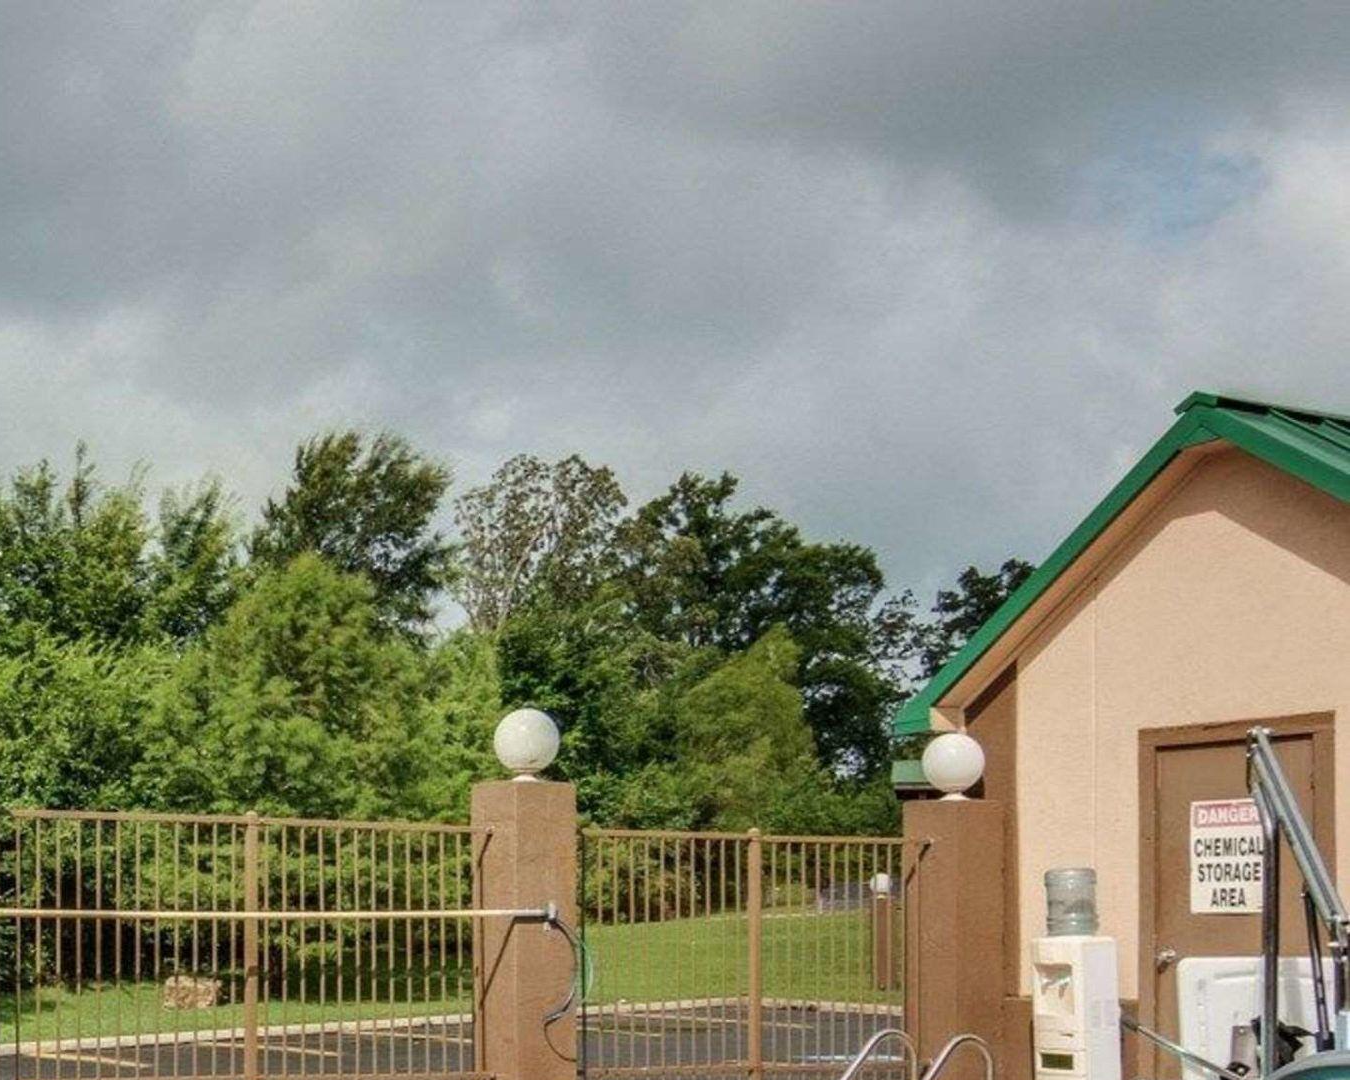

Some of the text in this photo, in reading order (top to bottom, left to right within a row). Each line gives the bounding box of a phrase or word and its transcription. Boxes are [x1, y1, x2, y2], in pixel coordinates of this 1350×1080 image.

[1194, 837, 1264, 857] CHEMICAL
[1198, 862, 1261, 882] STORAGE
[1211, 888, 1246, 907] AREA
